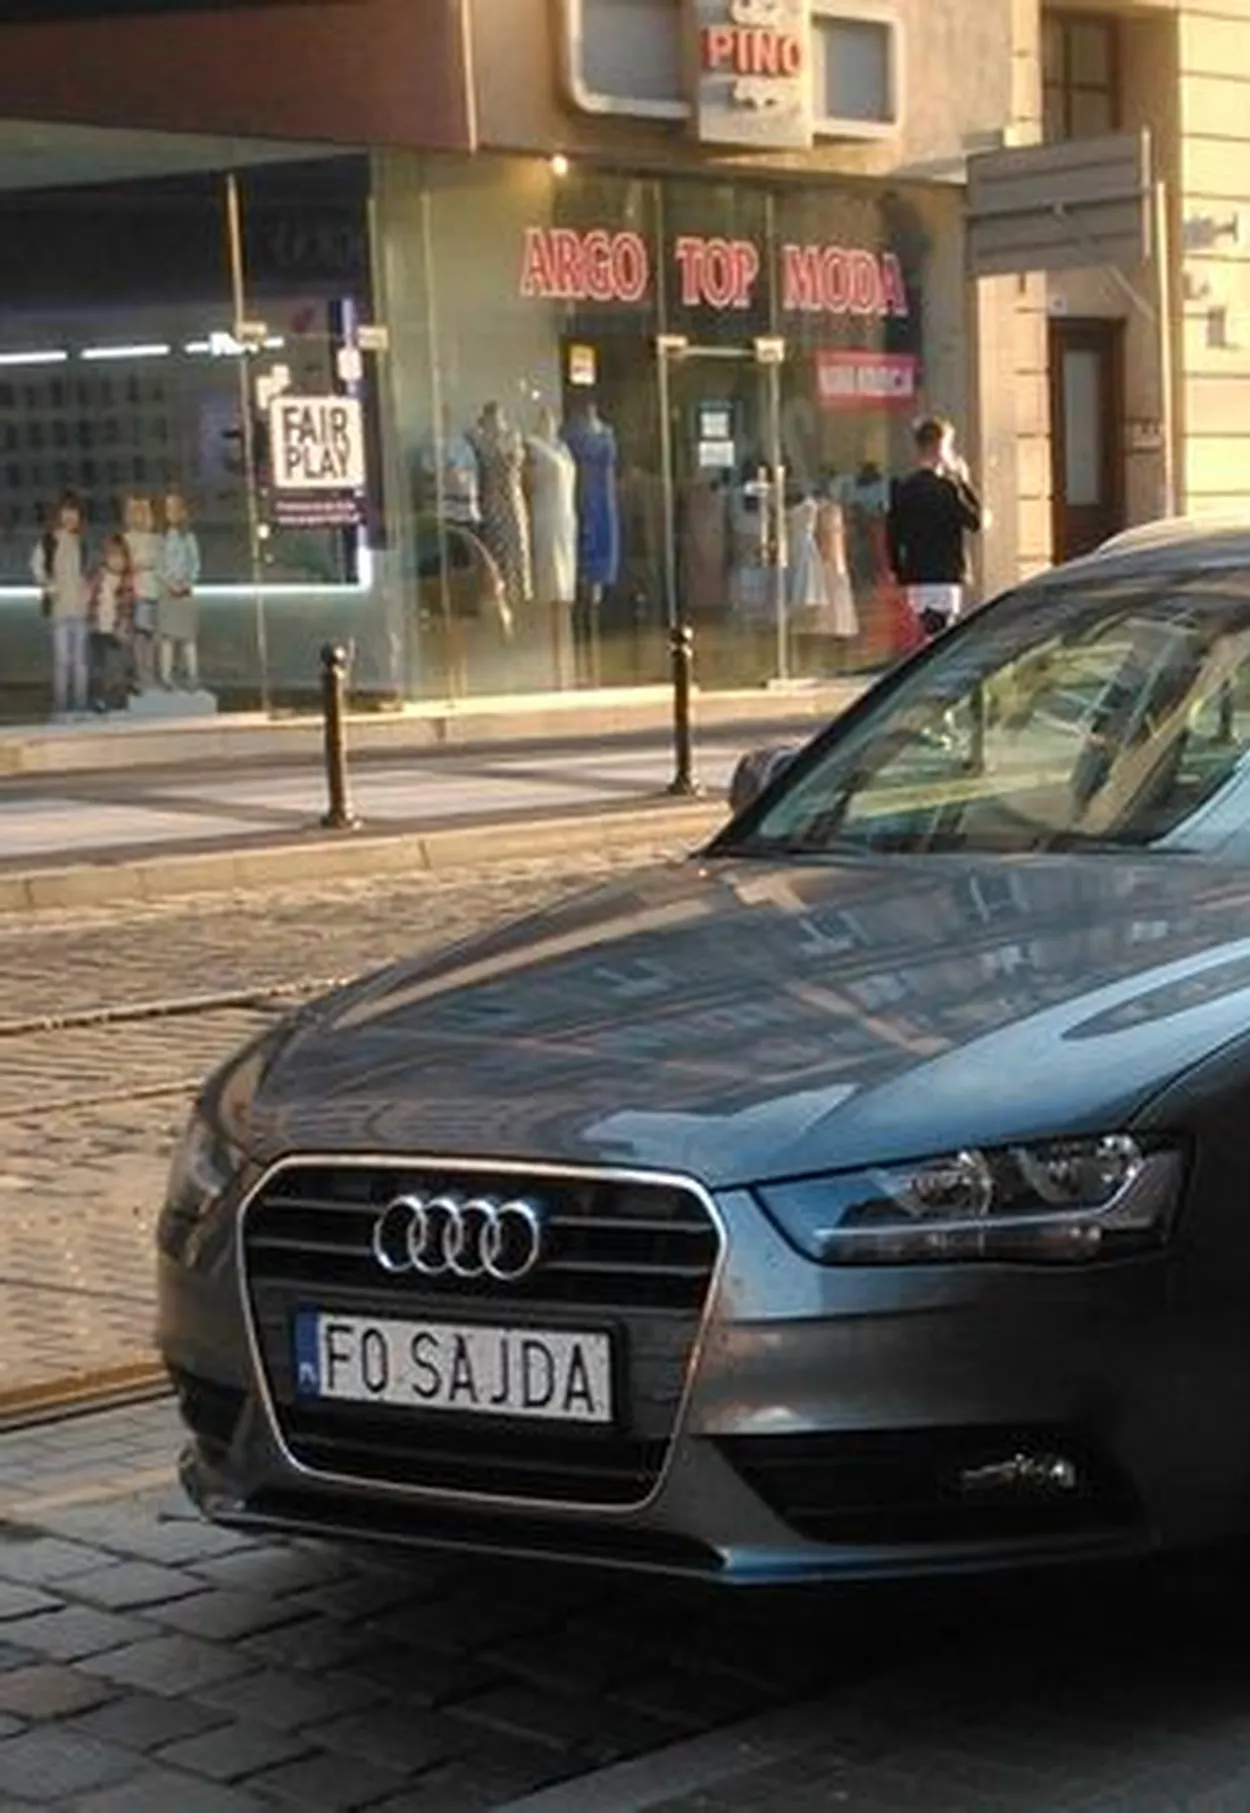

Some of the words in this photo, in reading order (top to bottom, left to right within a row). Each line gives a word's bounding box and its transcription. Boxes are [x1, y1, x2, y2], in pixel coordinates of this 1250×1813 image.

[520, 227, 648, 300] ARGO
[675, 237, 759, 308] TOP
[782, 244, 908, 316] MODA
[282, 406, 350, 446] FAIR
[285, 446, 351, 479] PLAY
[411, 1331, 595, 1413] SAJDA
